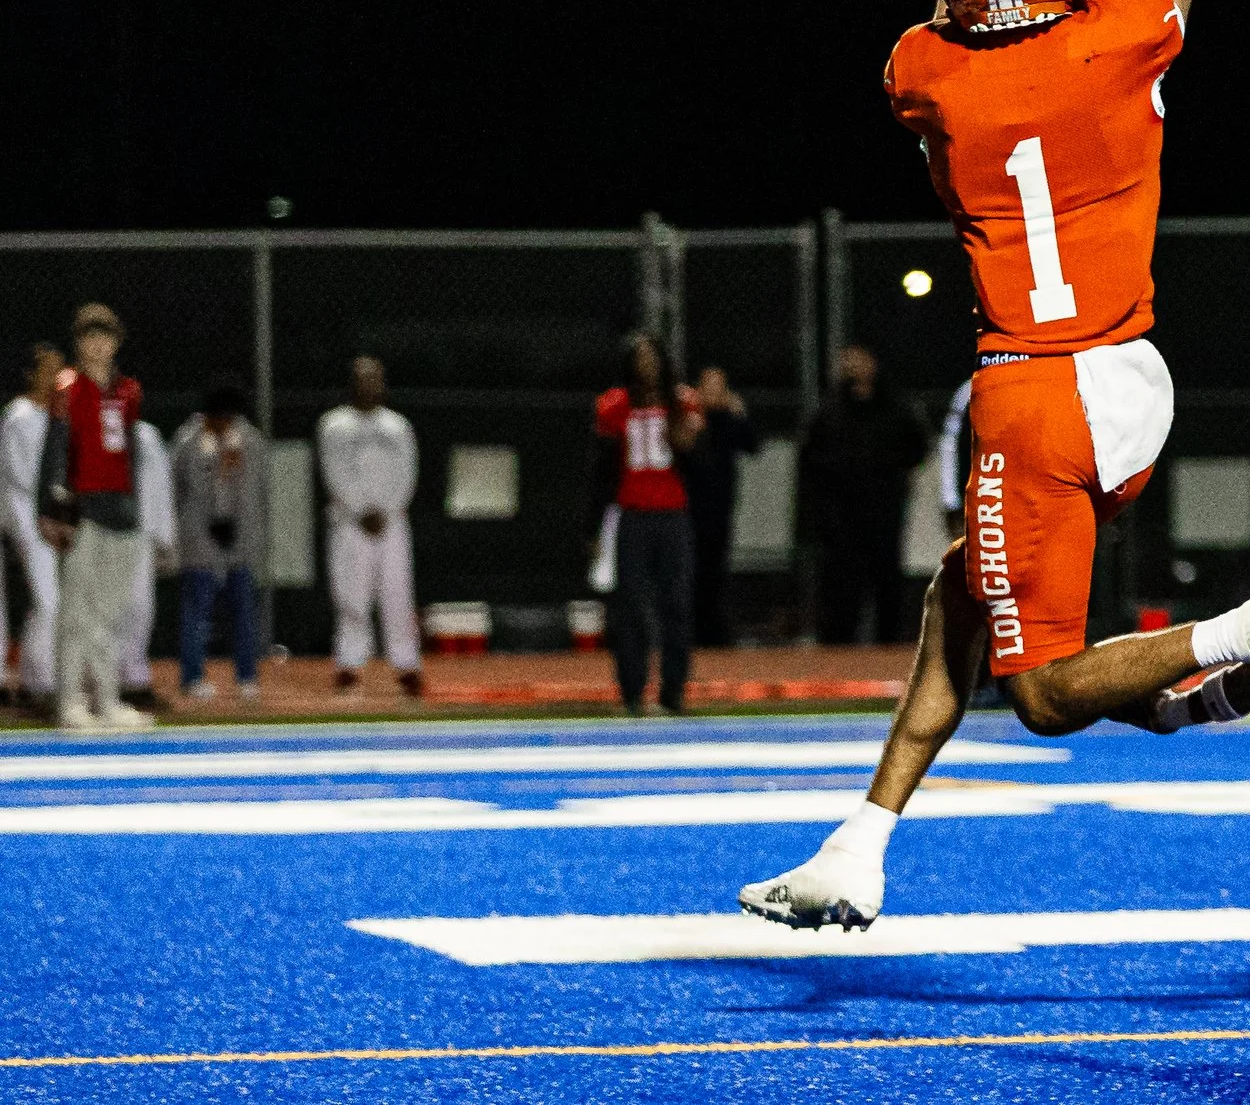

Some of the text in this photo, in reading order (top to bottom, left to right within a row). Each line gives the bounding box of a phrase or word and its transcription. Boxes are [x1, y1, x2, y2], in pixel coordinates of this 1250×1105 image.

[986, 6, 1030, 24] FAMILY
[1005, 136, 1078, 324] 1
[977, 452, 1025, 659] LONGHORNS
